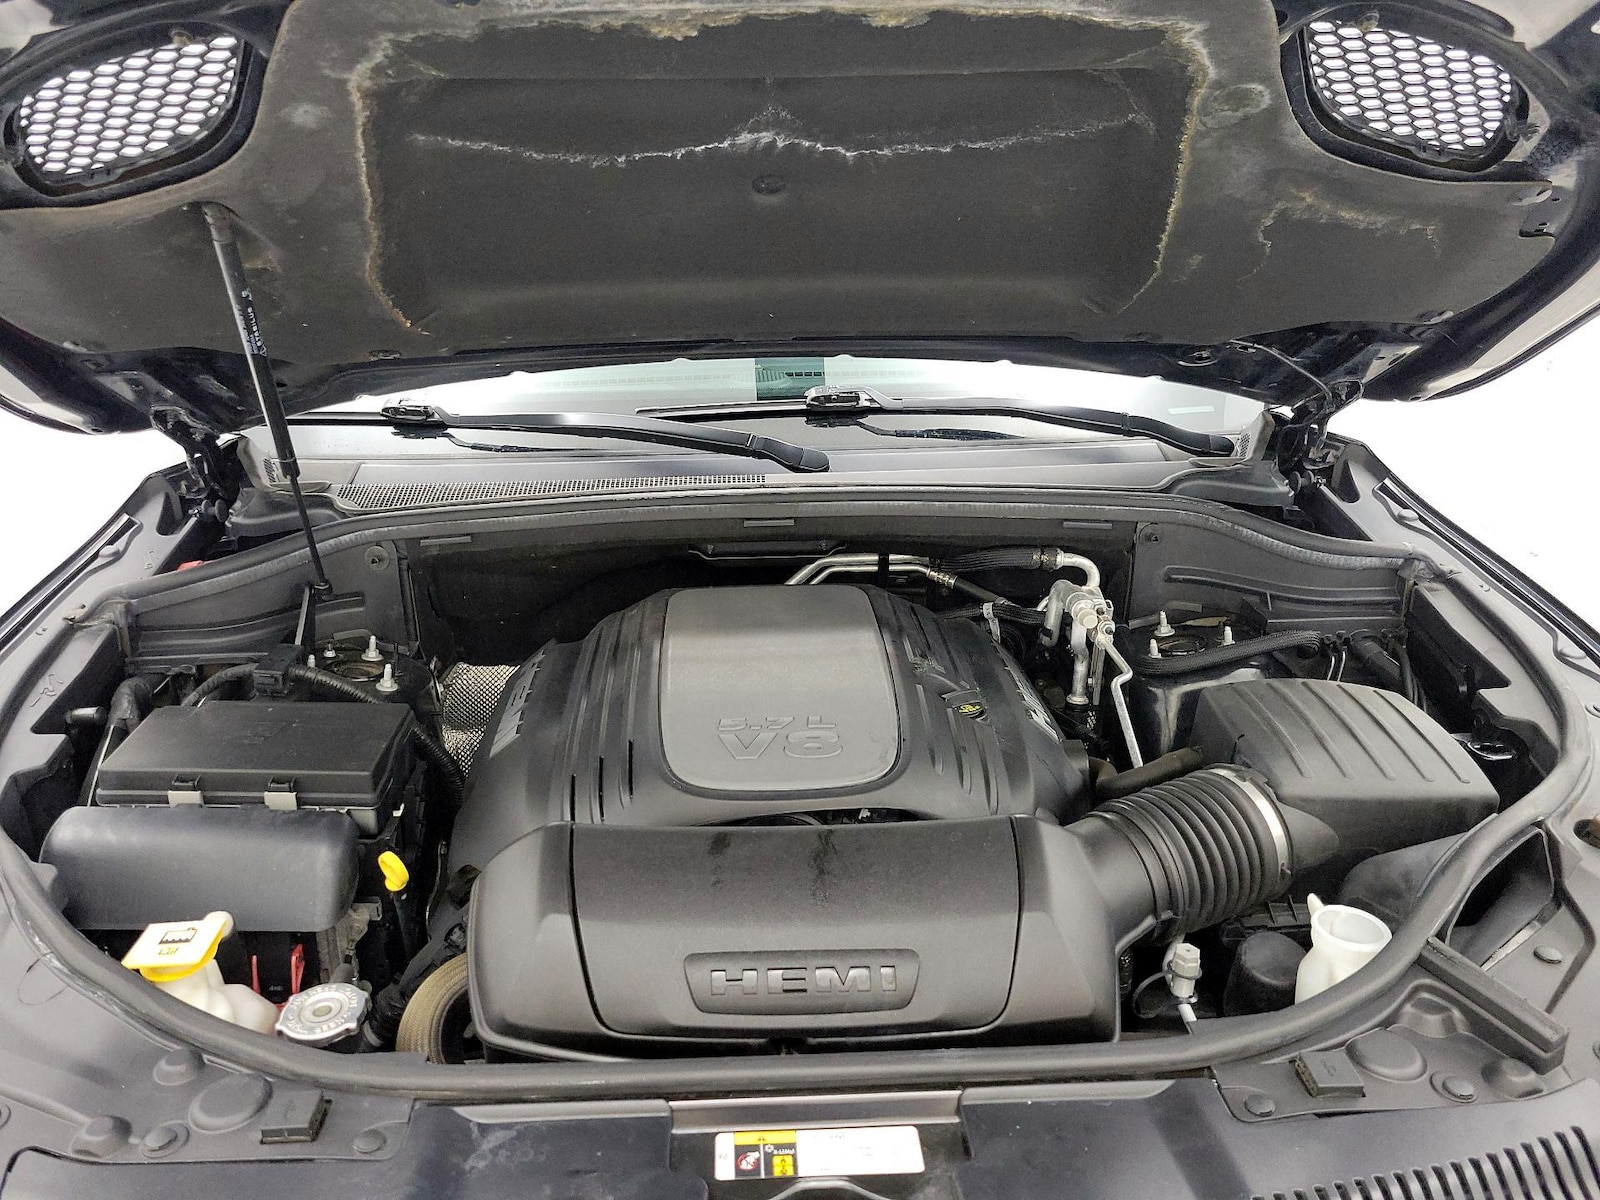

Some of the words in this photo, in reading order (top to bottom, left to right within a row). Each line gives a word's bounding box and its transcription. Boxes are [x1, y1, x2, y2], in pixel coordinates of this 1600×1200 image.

[717, 715, 795, 731] 5.7
[806, 715, 837, 728] L
[717, 730, 844, 760] V8
[710, 964, 897, 996] HEMI
